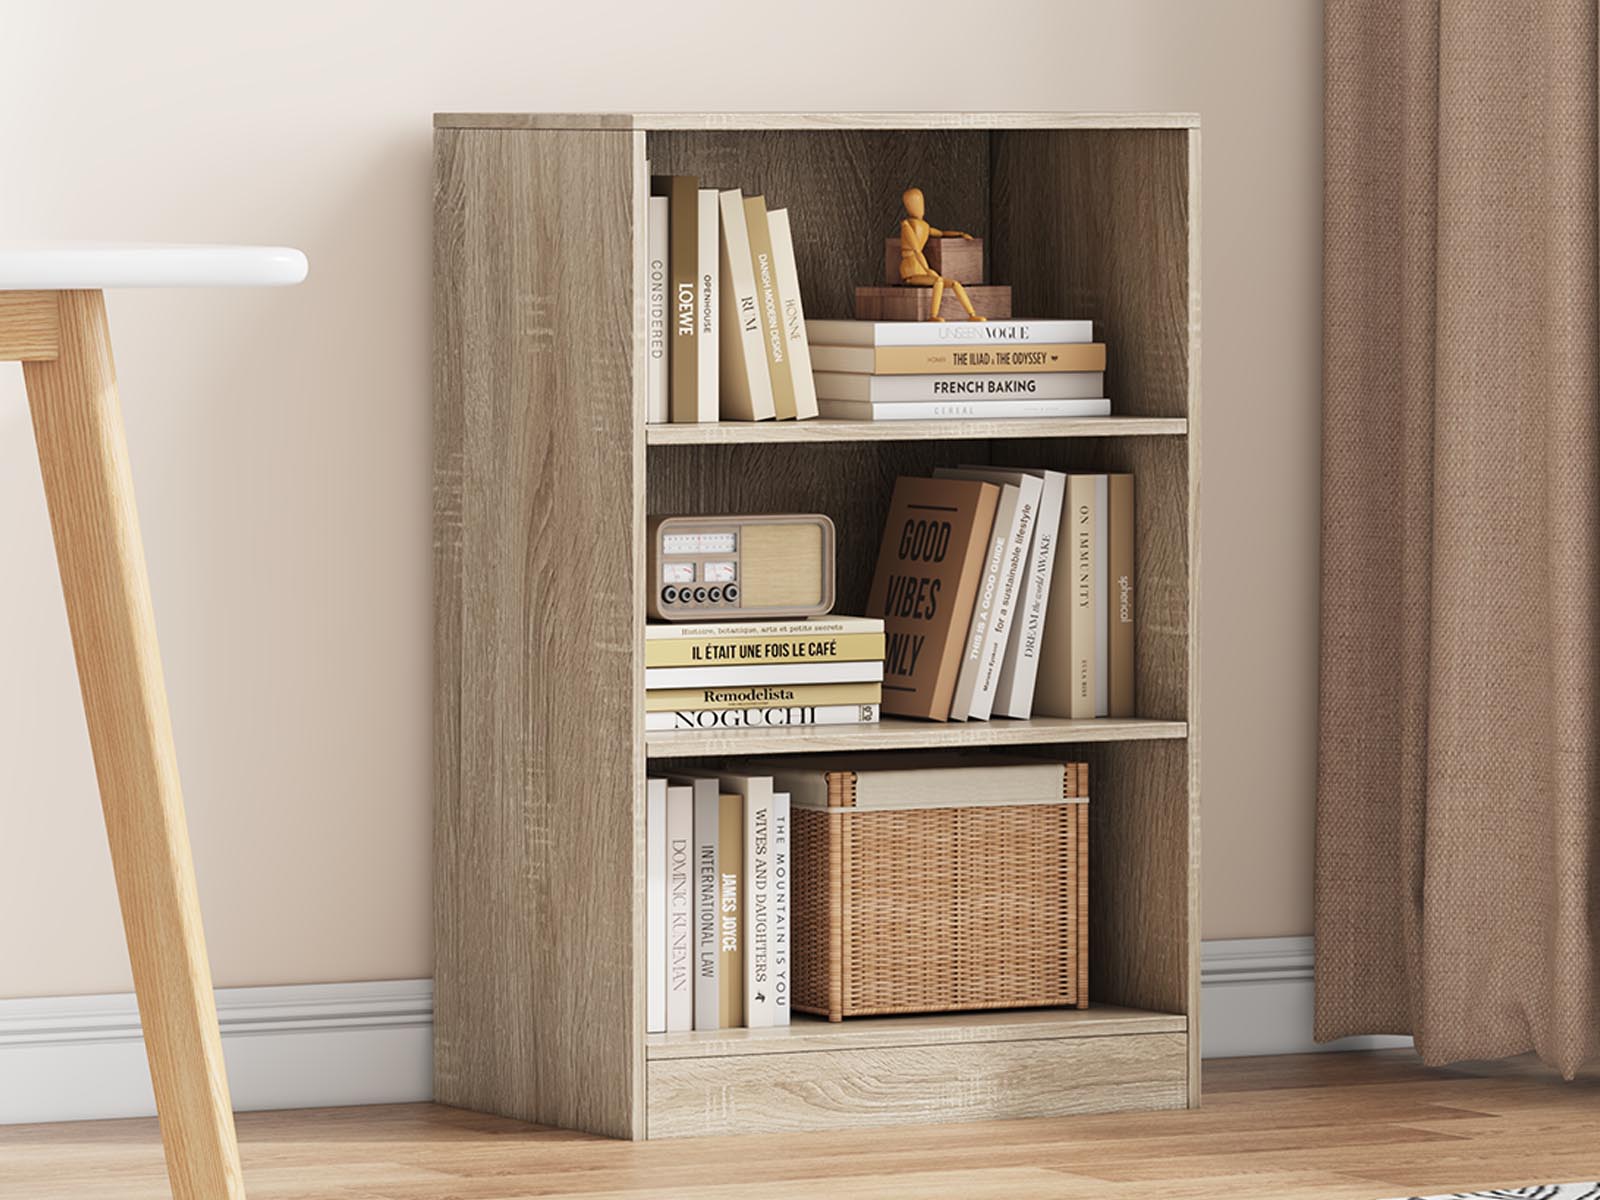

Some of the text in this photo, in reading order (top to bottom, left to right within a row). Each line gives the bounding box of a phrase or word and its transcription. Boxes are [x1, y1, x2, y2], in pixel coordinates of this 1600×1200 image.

[651, 260, 663, 359] CONSIDERED
[678, 282, 694, 336] LOEWE
[703, 274, 712, 333] OPENHOUSE
[741, 296, 758, 332] RUM
[758, 253, 784, 363] DANISH MODERN DESIGN
[953, 352, 968, 366] THE
[969, 352, 991, 366] ILIAD
[996, 352, 1011, 365] THE
[1012, 351, 1048, 365] ODYSSEY
[985, 326, 1030, 340] VOGUE
[934, 379, 1037, 394] FRENCH BAKING
[898, 518, 952, 563] GOOD
[1080, 505, 1089, 609] ON IMMUNITY
[994, 503, 1032, 633] for a sustainable lifestyle
[884, 575, 941, 620] VIBES
[1024, 614, 1039, 658] DREAM
[1032, 600, 1041, 613] the
[1037, 534, 1051, 575] AWAKE
[1118, 576, 1132, 624] spherical
[692, 639, 837, 660] IL ÉTAIT UNE FOIS LE CAFÉ
[761, 625, 778, 633] arts
[814, 624, 844, 632] secrets
[674, 707, 816, 729] NOGUCHI
[704, 688, 795, 703] Remodelista
[672, 840, 687, 907] DOMINIC
[755, 808, 768, 983] WIVES AND DAUGHTERS
[701, 845, 714, 978] INTERNATIONAL LAW
[722, 873, 737, 952] JAMES JOYCE
[776, 816, 786, 1006] THE MOUNTAIN IS YOU
